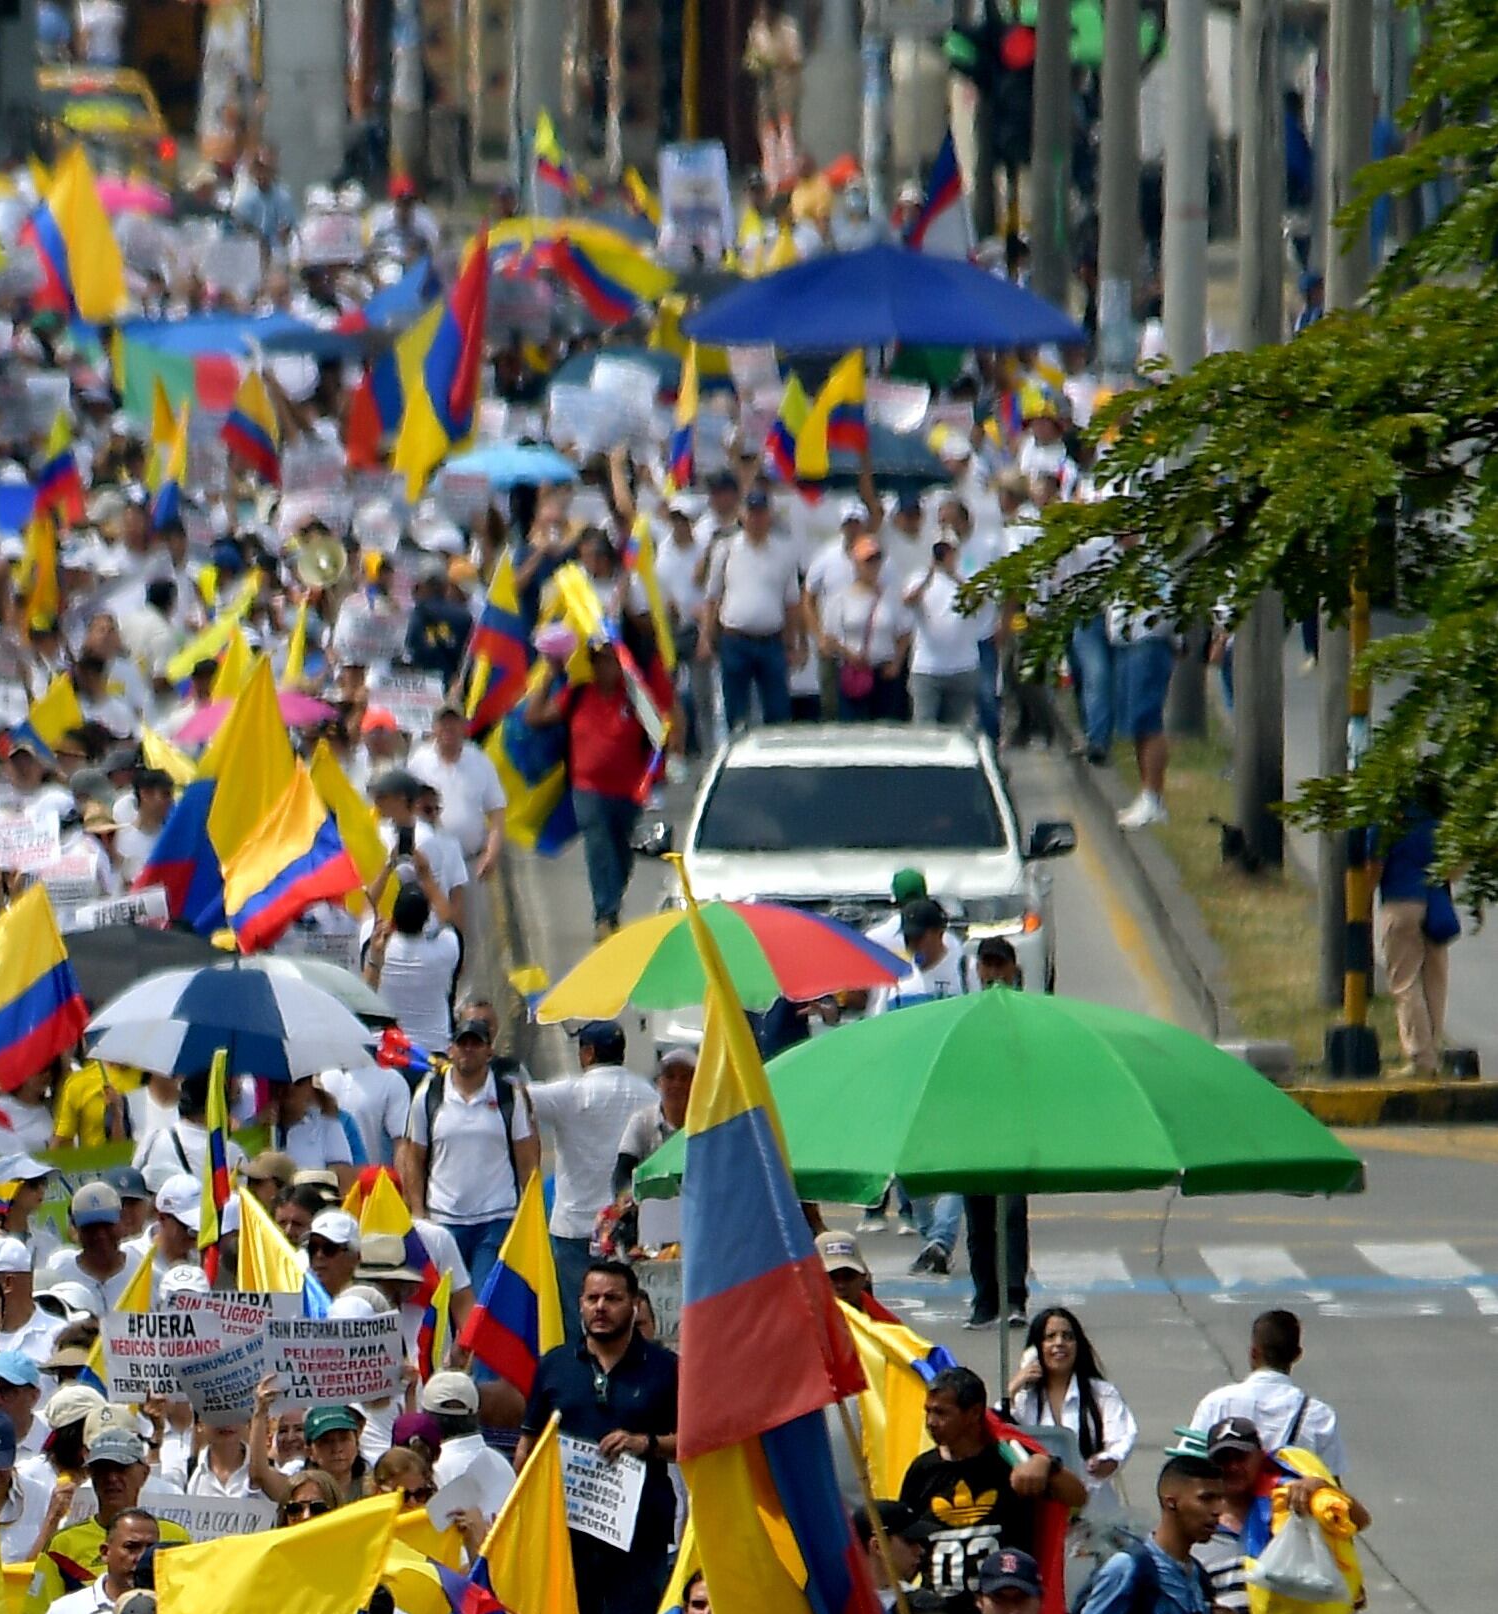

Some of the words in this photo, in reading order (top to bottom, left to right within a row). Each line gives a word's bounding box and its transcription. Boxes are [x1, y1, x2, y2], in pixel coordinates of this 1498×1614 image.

[128, 1314, 197, 1338] #FUERA
[342, 1317, 398, 1338] ELECTORAL
[158, 1339, 221, 1358] CUBANOS
[283, 1347, 345, 1360] PELIGRO
[349, 1343, 387, 1359] PARA
[130, 1363, 142, 1378] EN
[144, 1363, 175, 1379] COLO
[275, 1360, 294, 1373] LA
[153, 1379, 174, 1394] LOS
[292, 1374, 309, 1387] LA
[313, 1369, 383, 1387] LIBERTAD
[283, 1387, 292, 1399] Y
[295, 1388, 313, 1399] LA
[565, 1487, 619, 1511] TENDEROS
[579, 1480, 621, 1502] ABUSOS
[213, 1509, 241, 1533] COCA
[568, 1512, 622, 1541] INCUENTES
[609, 1516, 617, 1526] A
